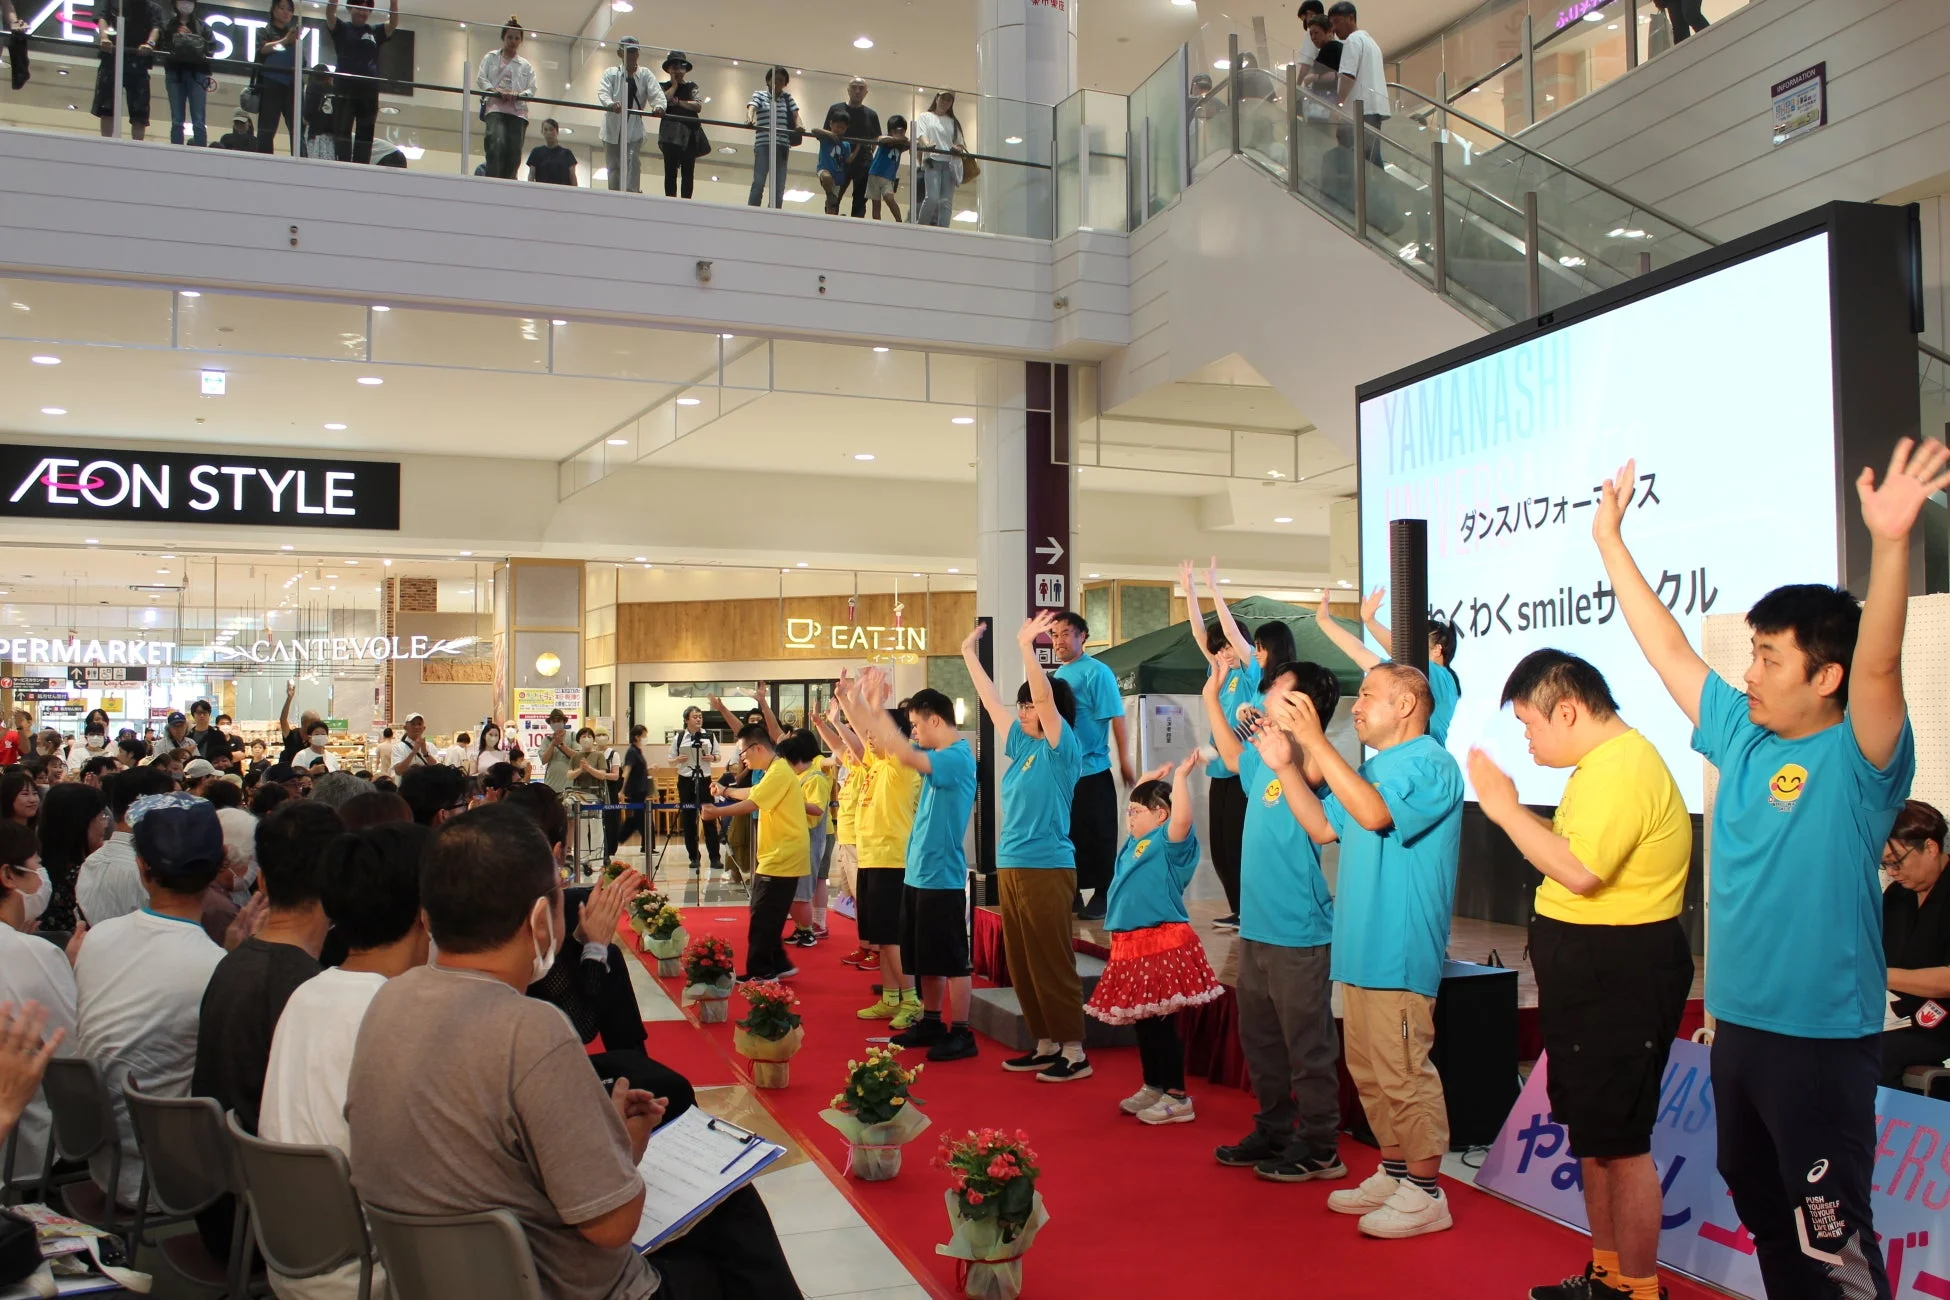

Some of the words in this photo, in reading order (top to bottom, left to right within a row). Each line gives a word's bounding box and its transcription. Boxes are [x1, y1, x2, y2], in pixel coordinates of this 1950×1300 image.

[1776, 68, 1816, 92] INFORMATION
[1384, 332, 1572, 476] YAMANASHI
[188, 465, 356, 516] STYLE
[1460, 473, 1661, 543] ダンスパフォース
[831, 626, 886, 650] EAT
[895, 626, 926, 650] IN
[251, 635, 430, 662] CANTEVOLE
[872, 654, 914, 663] イートイン
[1805, 1195, 1824, 1203] PUSH
[1807, 1200, 1840, 1211] YOURSELF
[1810, 1210, 1818, 1218] TO
[1817, 1208, 1835, 1217] YOUR
[1813, 1223, 1828, 1231] LIVE
[1828, 1222, 1835, 1230] IN
[1834, 1220, 1845, 1228] THE
[1816, 1228, 1842, 1238] MOMENT
